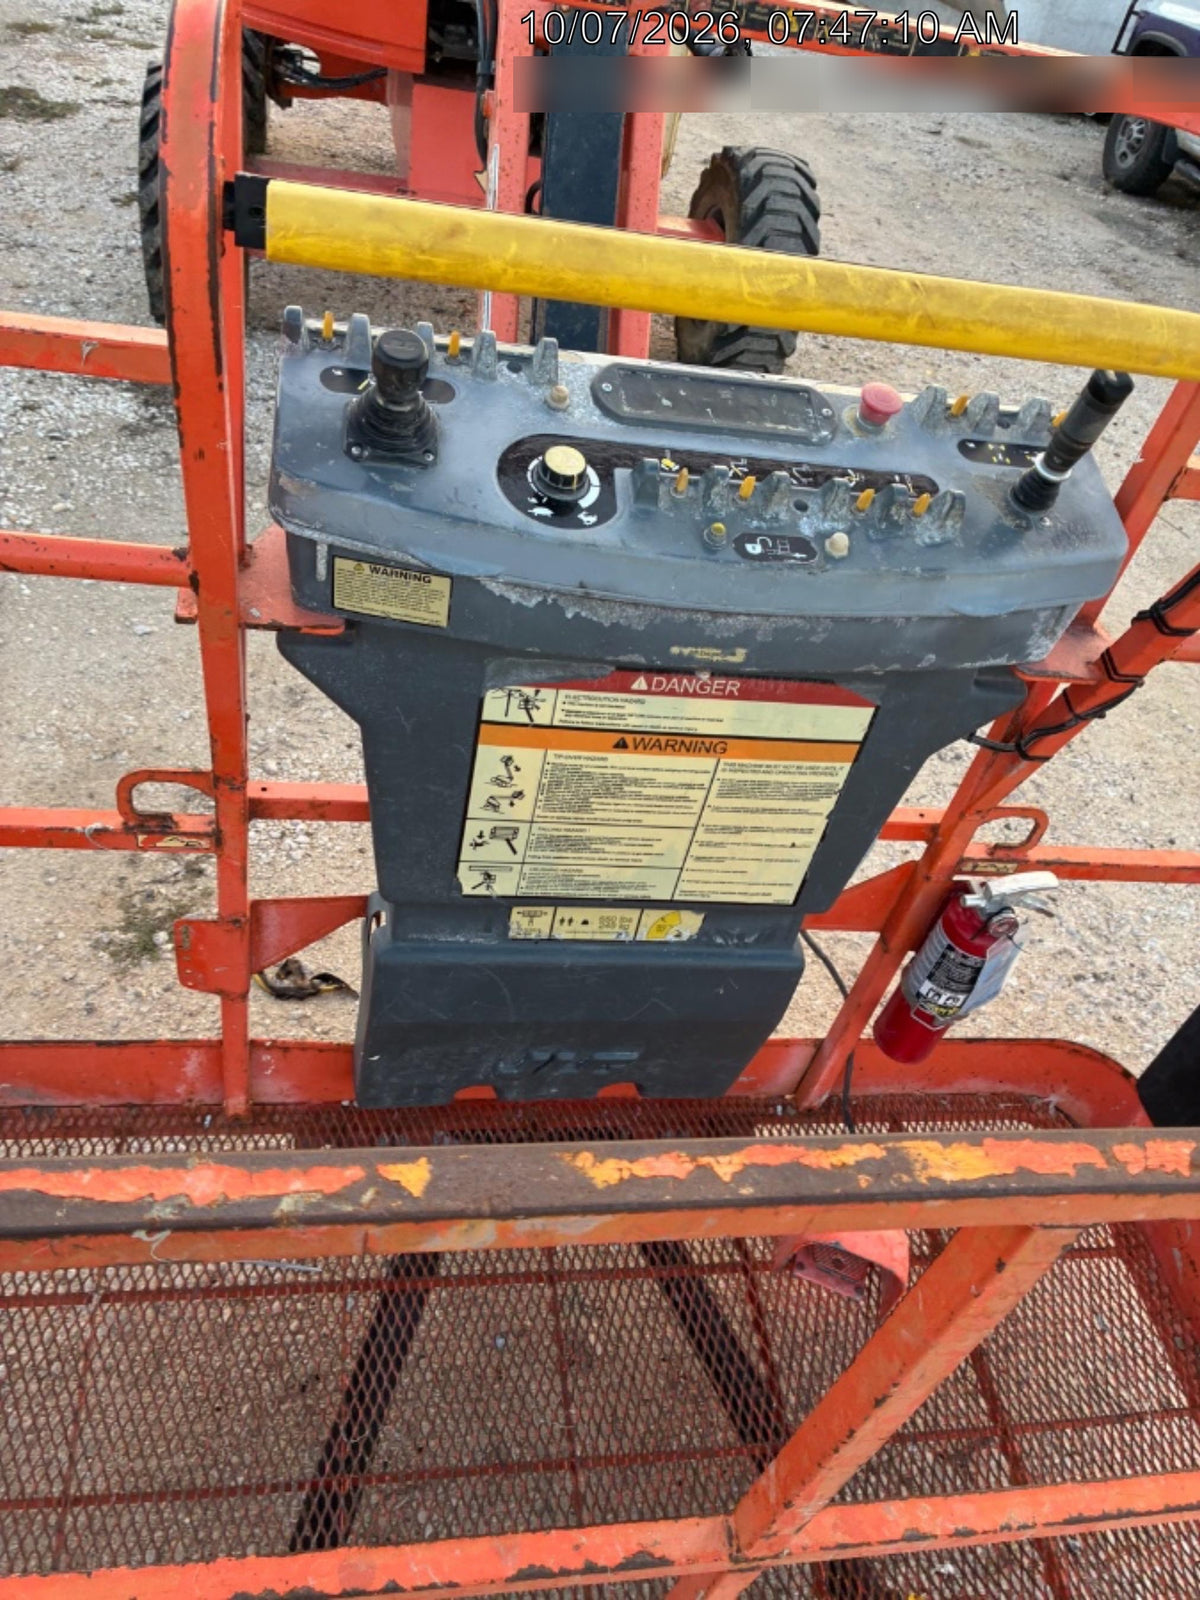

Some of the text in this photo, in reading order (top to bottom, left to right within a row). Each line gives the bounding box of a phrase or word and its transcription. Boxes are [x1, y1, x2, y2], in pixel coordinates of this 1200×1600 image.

[369, 565, 431, 584] WARNING
[651, 676, 740, 696] DANGER
[631, 736, 728, 755] WARNING
